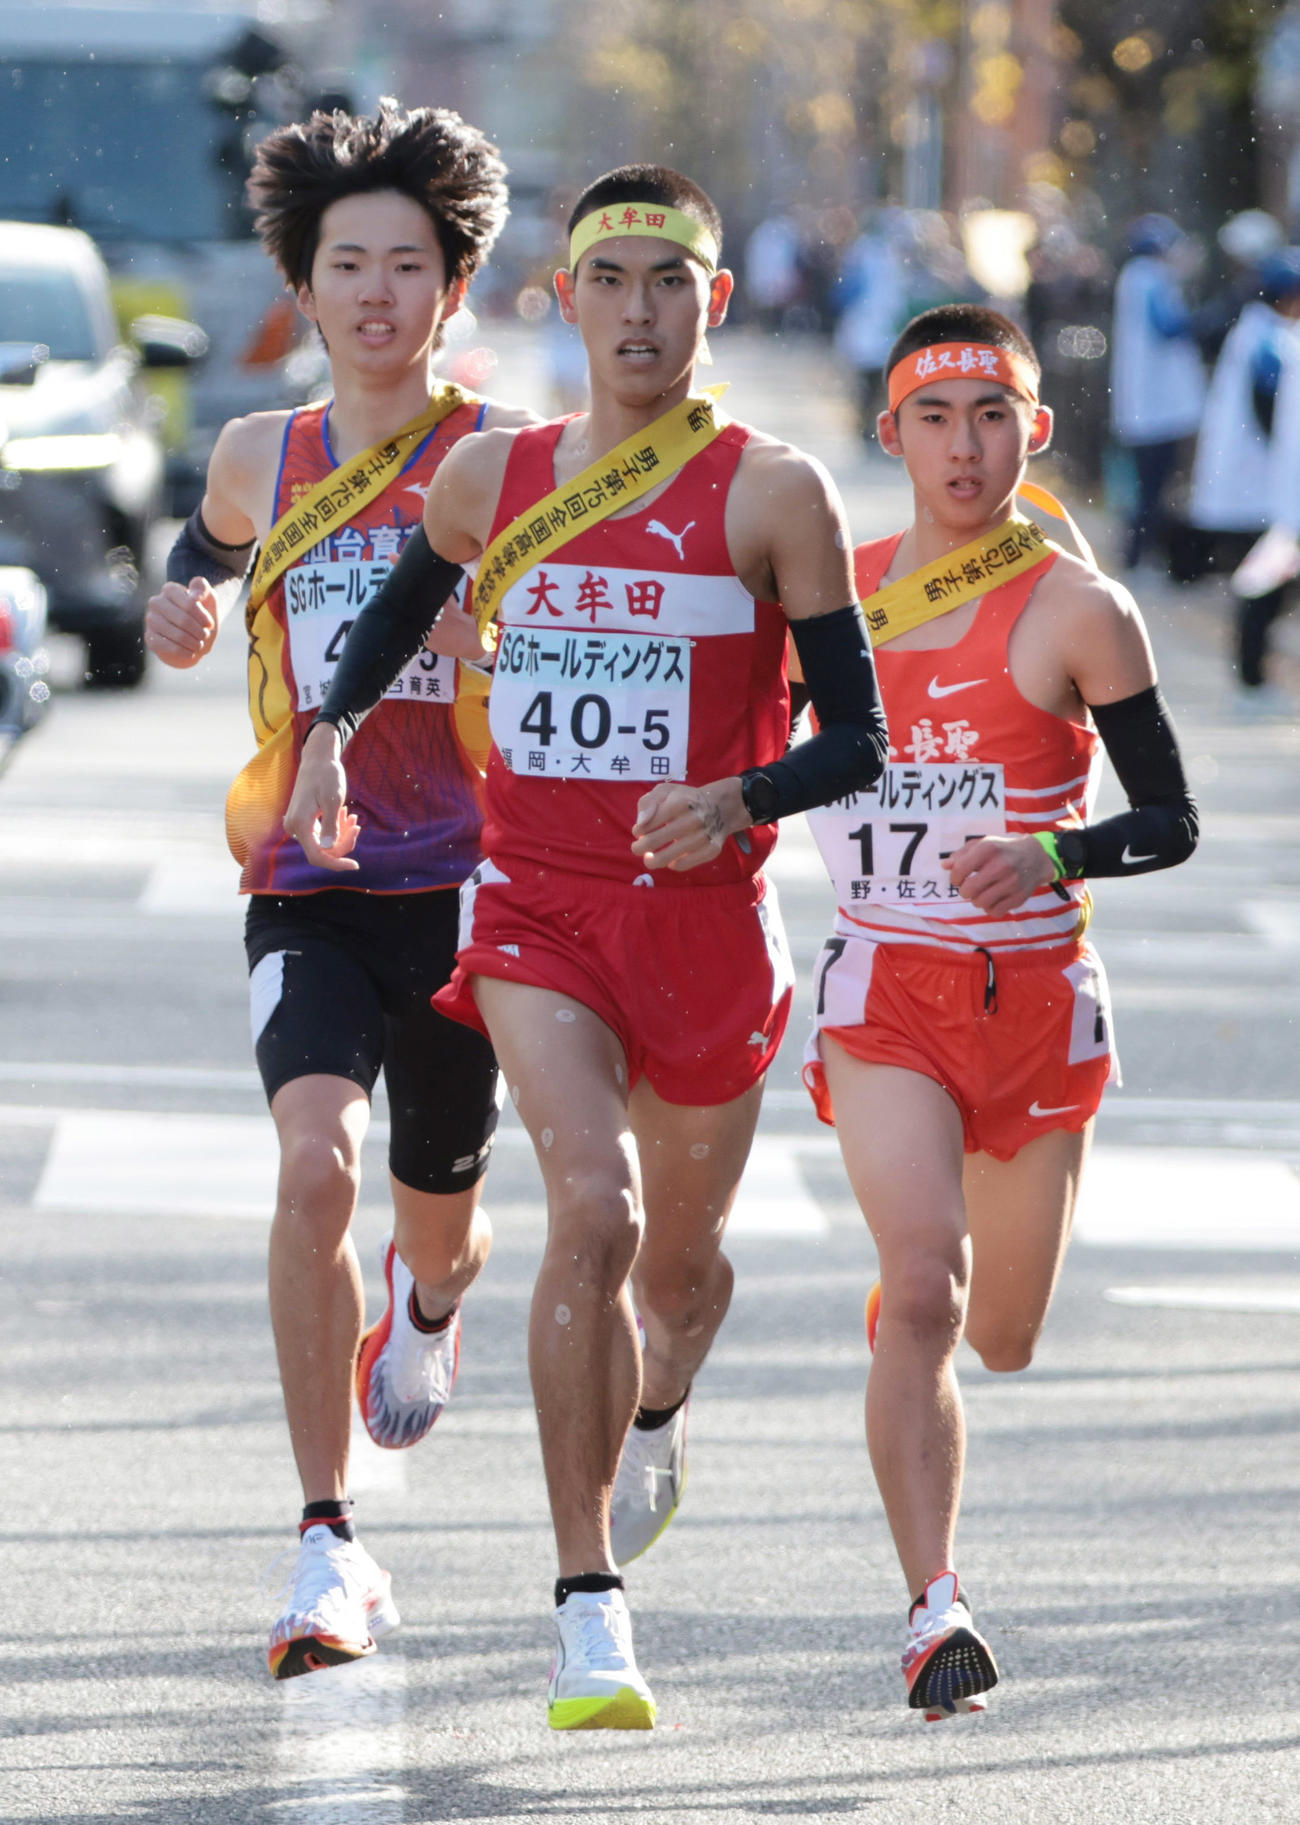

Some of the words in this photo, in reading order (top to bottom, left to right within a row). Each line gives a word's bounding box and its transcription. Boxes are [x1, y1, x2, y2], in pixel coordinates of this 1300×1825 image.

[596, 206, 666, 233] 大牟田
[914, 347, 999, 379] 佐久長聖
[525, 570, 666, 624] 大牟田
[499, 632, 685, 684] SGホールディングス
[519, 690, 671, 751] 40-5
[848, 822, 987, 877] 17-
